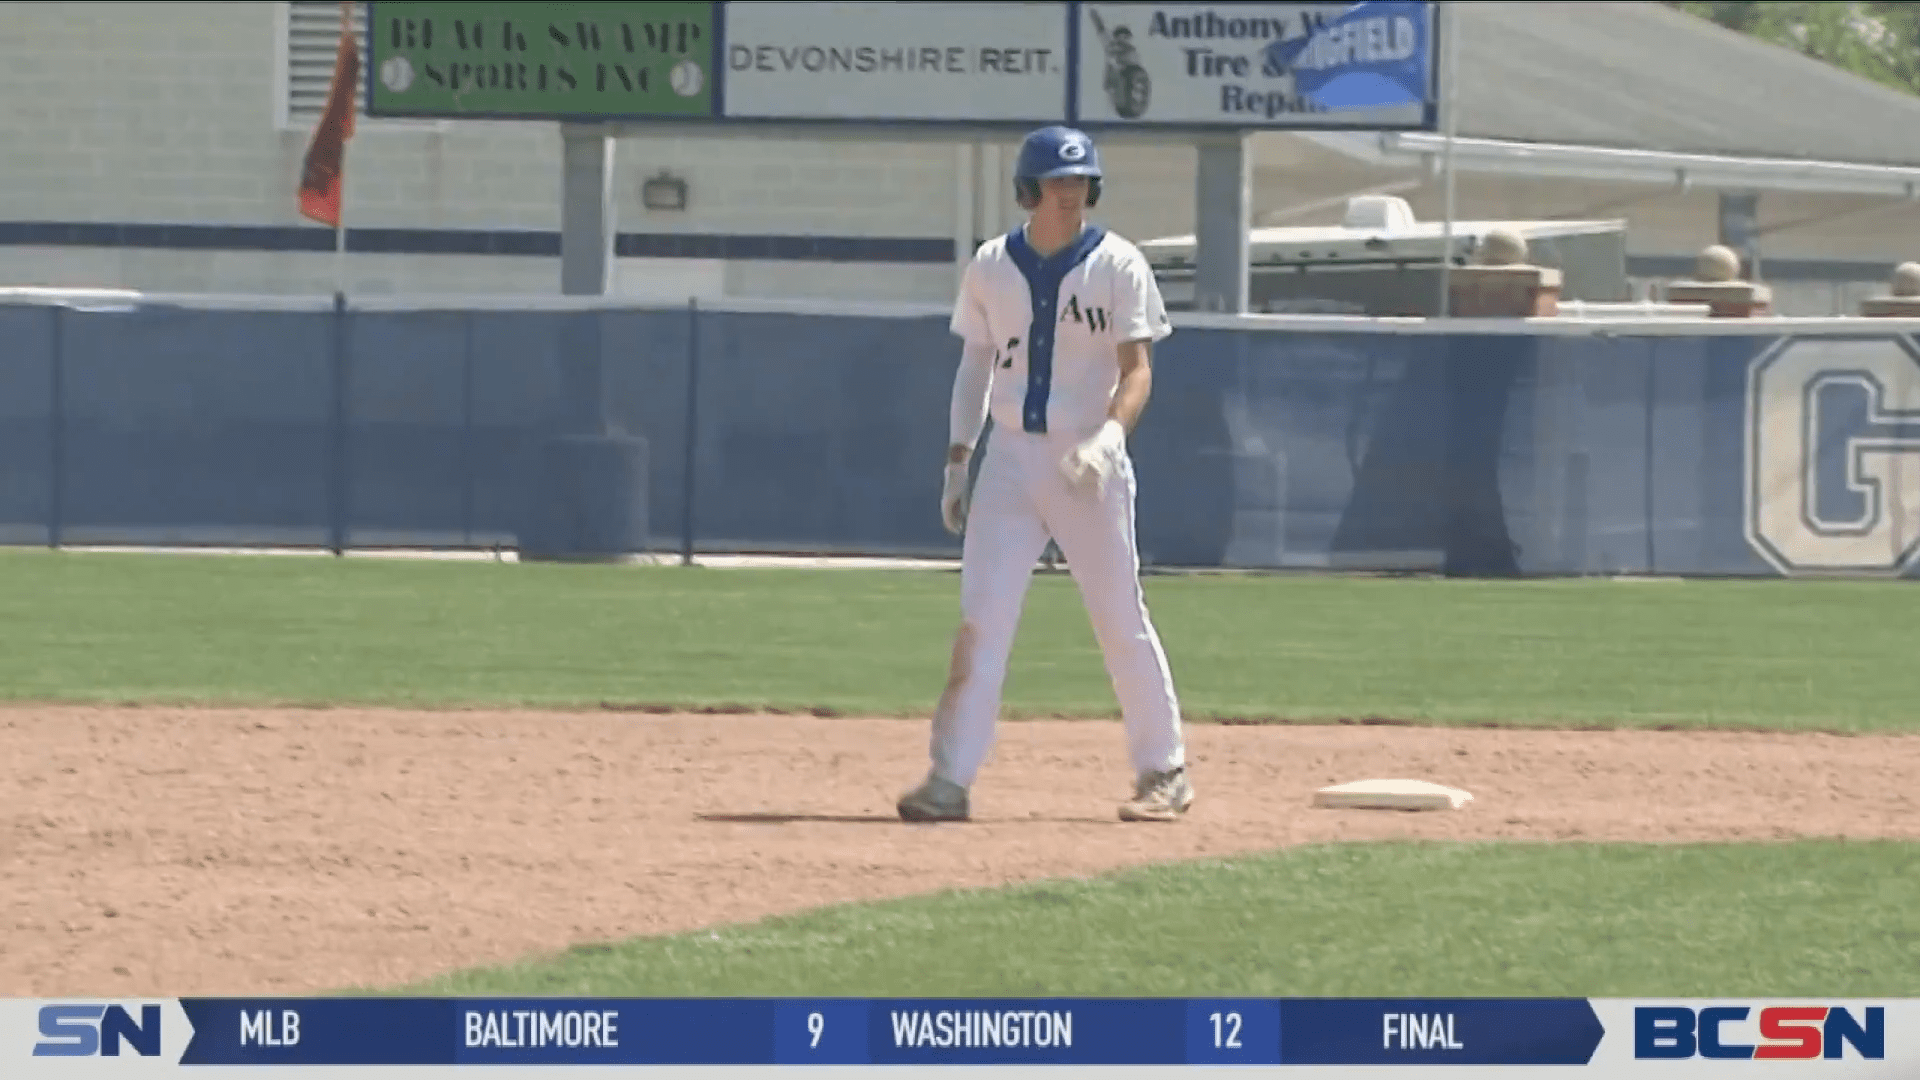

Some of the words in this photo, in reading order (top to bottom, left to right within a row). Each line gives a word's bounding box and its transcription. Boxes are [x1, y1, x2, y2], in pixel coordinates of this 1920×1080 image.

[389, 17, 528, 52] BLACK
[548, 21, 702, 54] SWAMP
[1149, 10, 1288, 41] Anthony
[729, 44, 966, 74] DEVONSHIRE
[1181, 46, 1251, 78] Tire
[423, 61, 578, 93] SPORTS
[594, 62, 651, 94] INC
[1744, 333, 1919, 578] G
